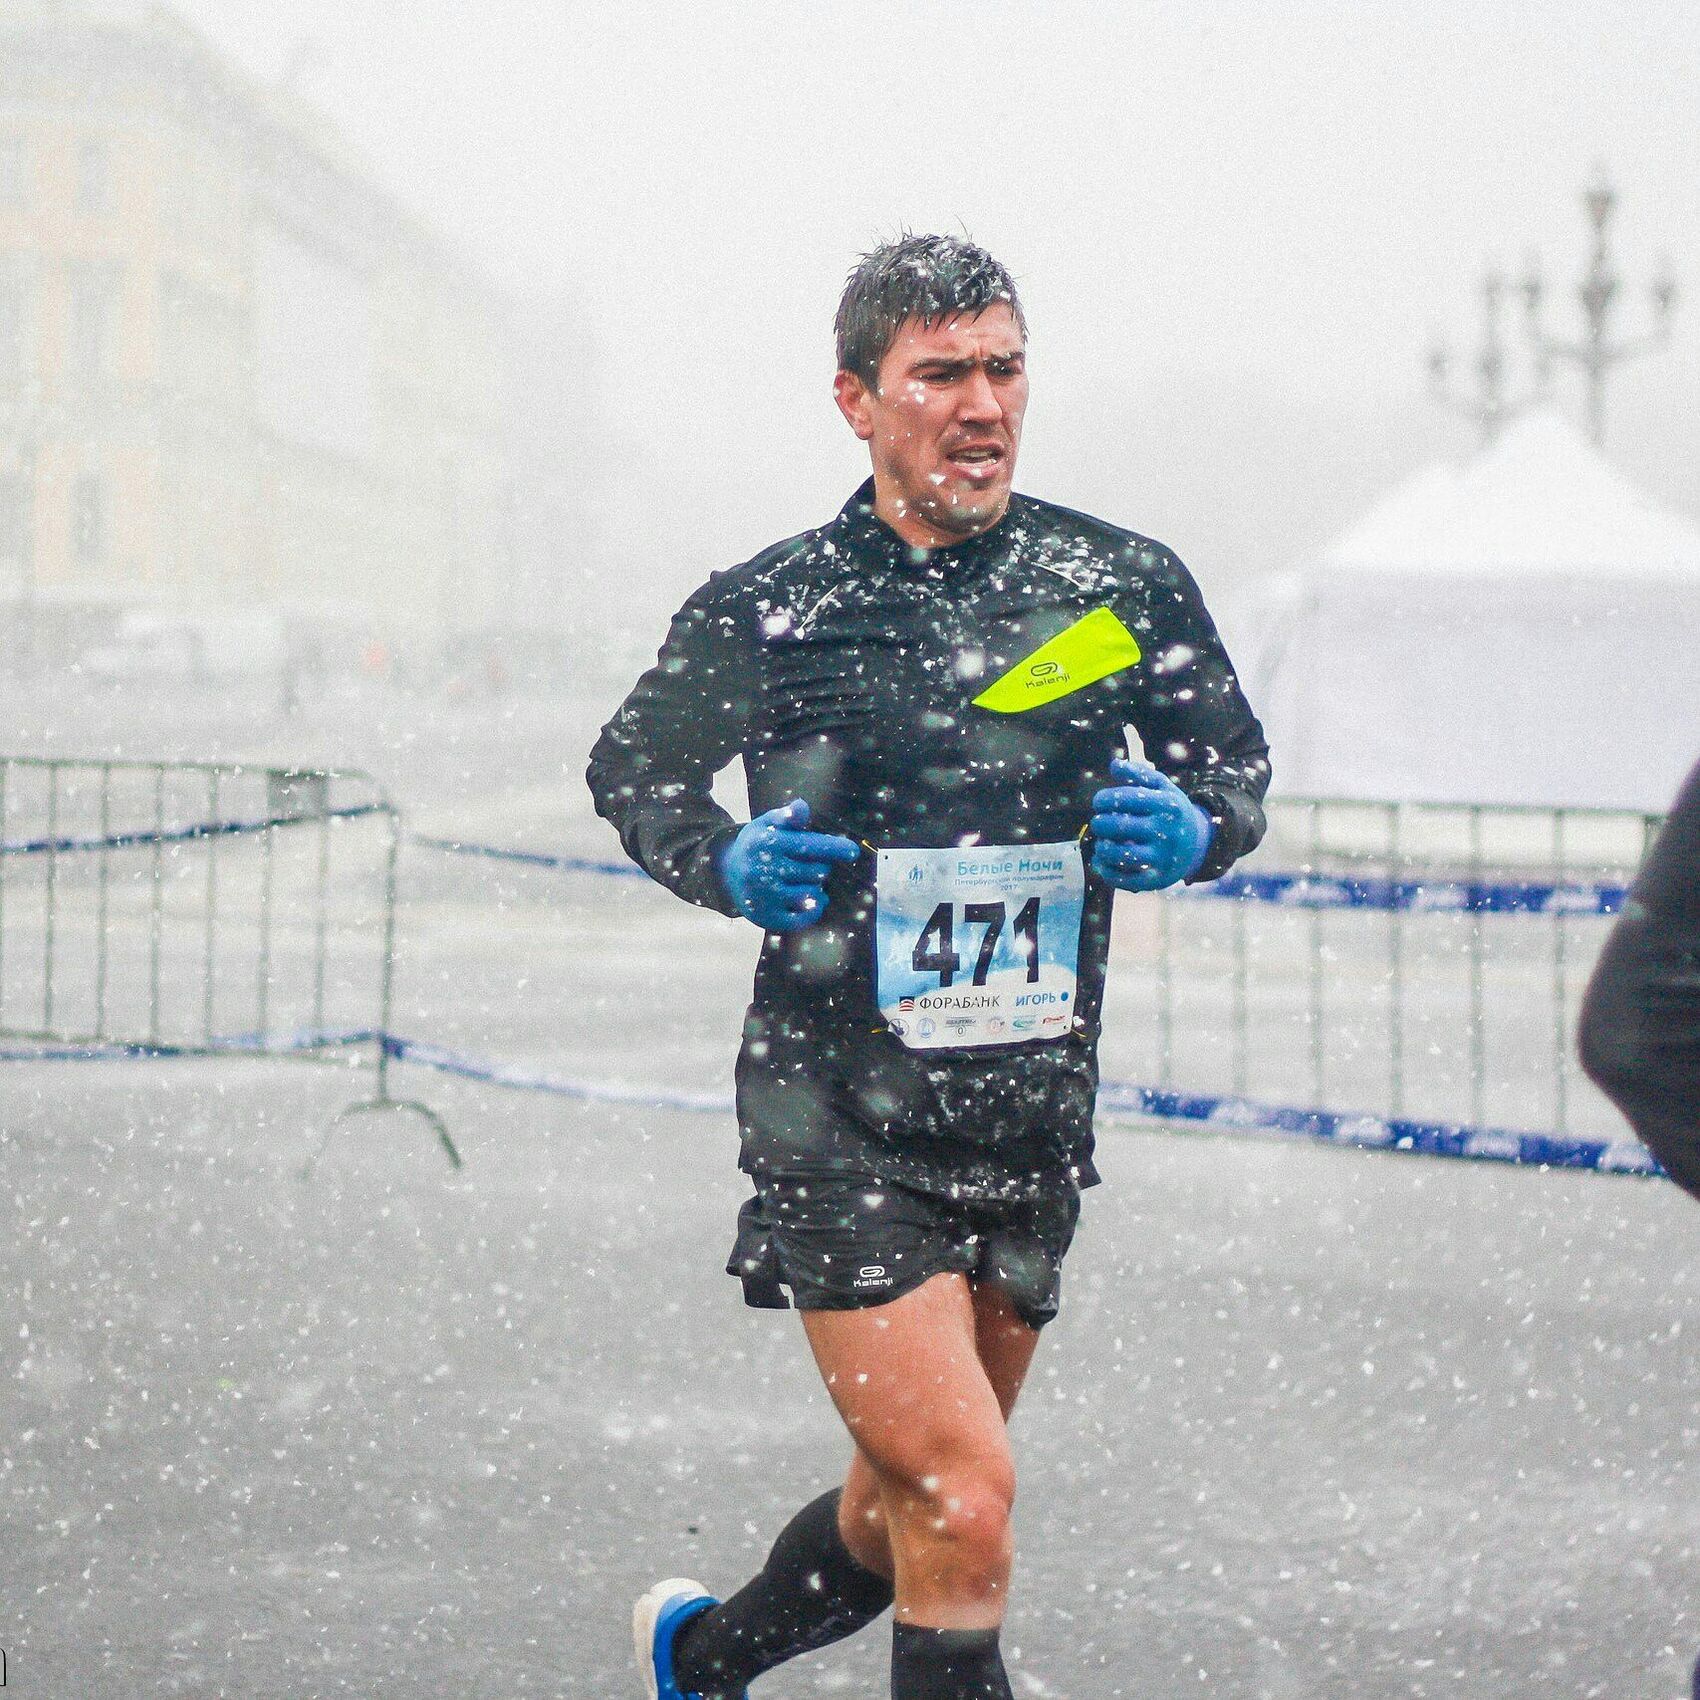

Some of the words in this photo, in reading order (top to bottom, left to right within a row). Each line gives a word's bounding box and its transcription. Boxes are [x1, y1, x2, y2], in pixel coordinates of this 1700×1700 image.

[1025, 673, 1071, 689] Kalenji
[957, 860, 1013, 876] Белые
[1018, 858, 1063, 872] Ночи
[912, 897, 1041, 987] 471
[919, 995, 1001, 1010] ФОРАБАНК
[1015, 992, 1056, 1007] ИГОРЬ
[853, 1277, 894, 1288] Kalenji
